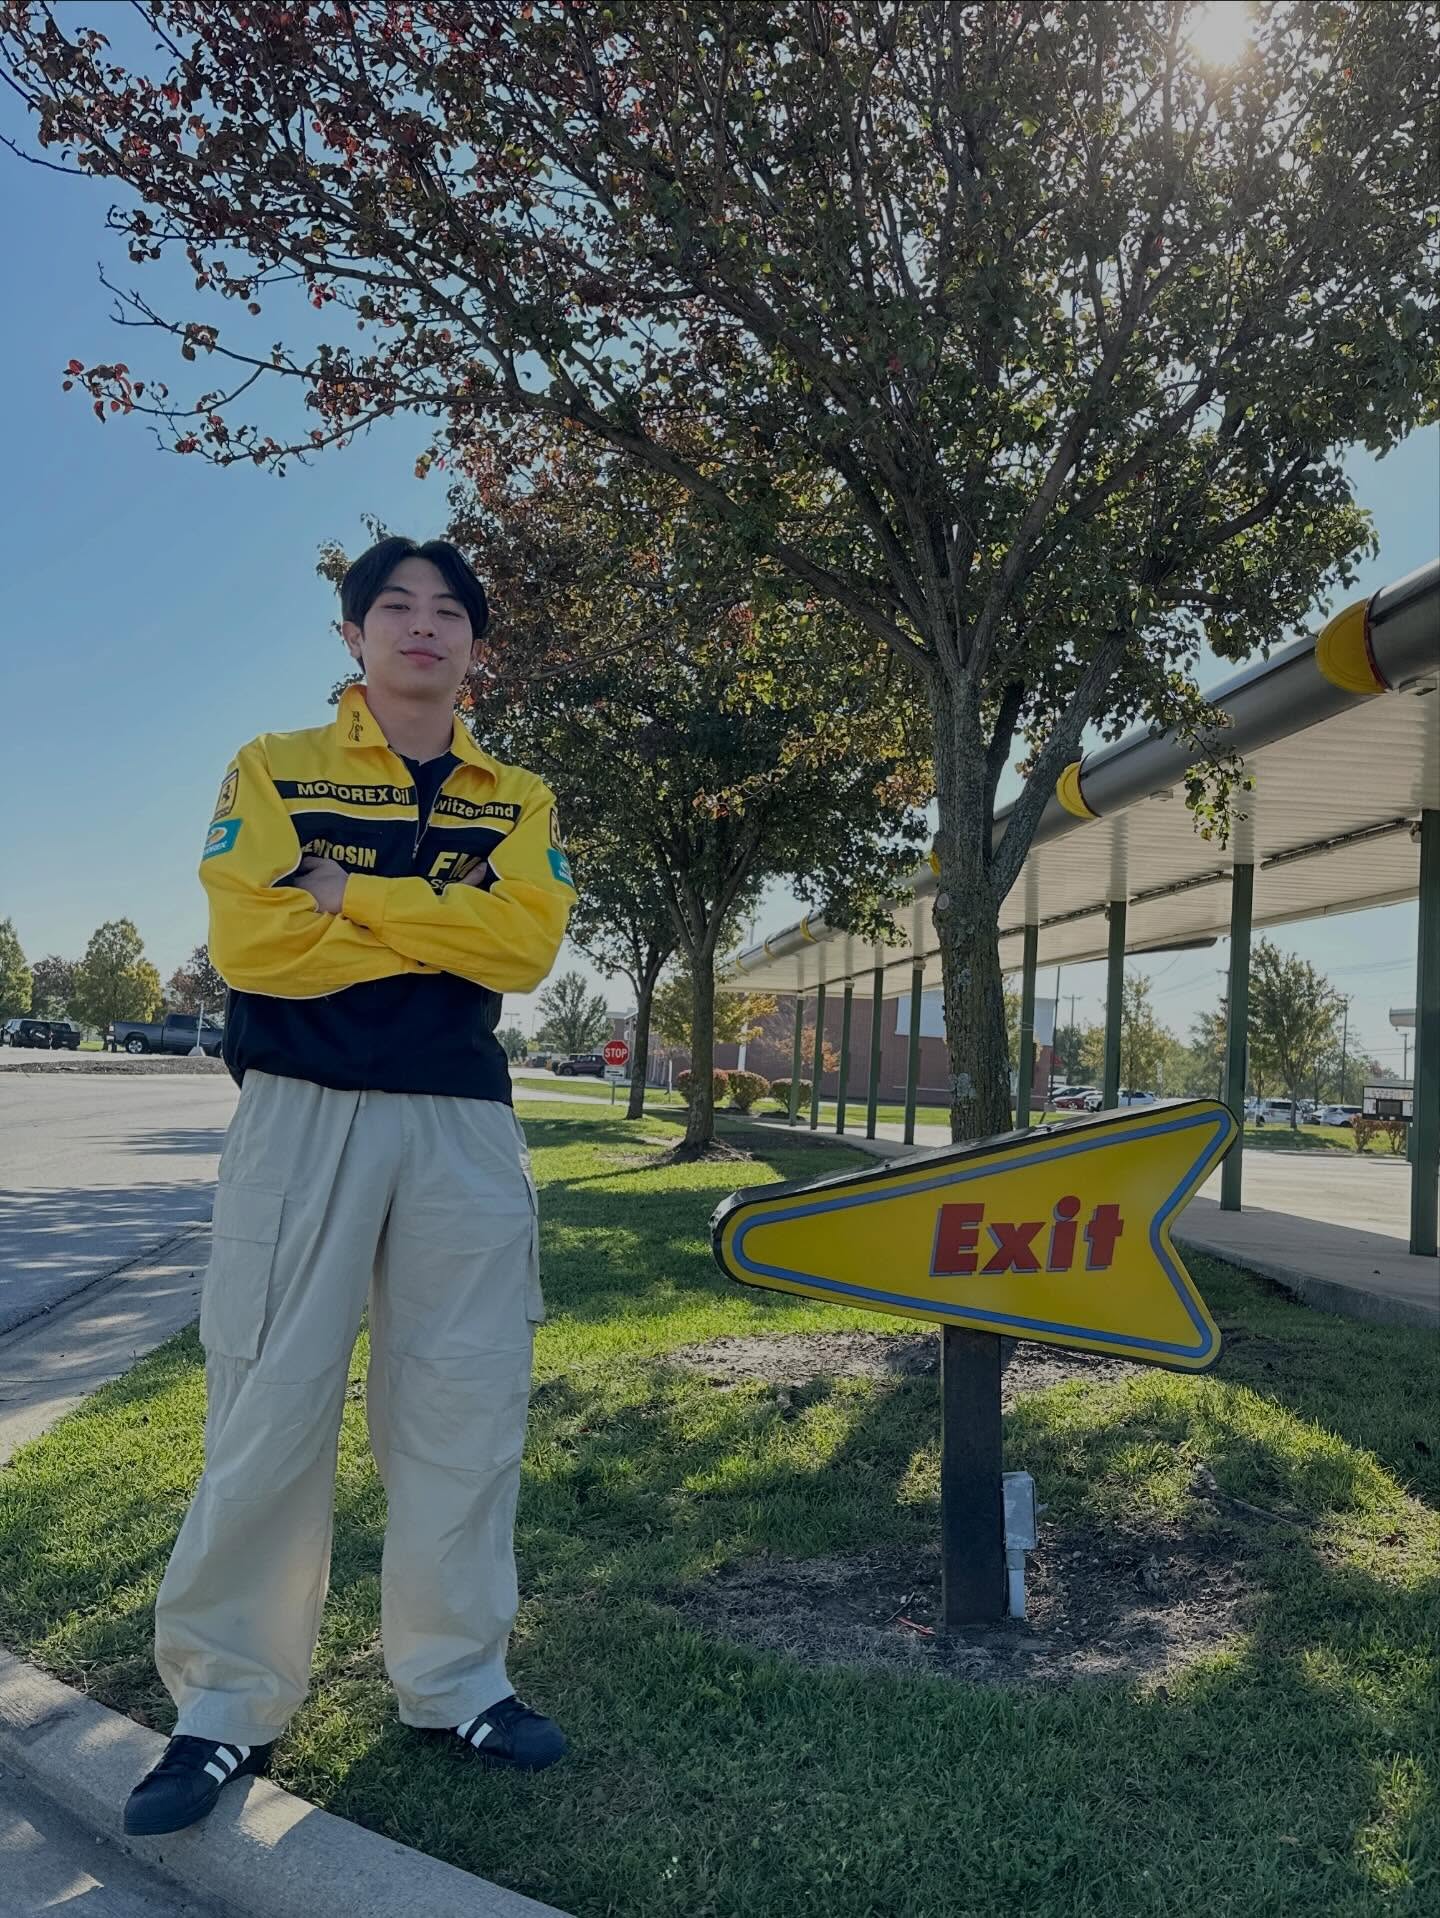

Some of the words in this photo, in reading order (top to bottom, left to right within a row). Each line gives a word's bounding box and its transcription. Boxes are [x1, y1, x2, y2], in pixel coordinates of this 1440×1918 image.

[297, 782, 389, 803] MOTOREX
[392, 787, 411, 805] Oil
[434, 798, 515, 818] witzerland
[301, 838, 377, 869] ENTOSIN
[604, 1047, 628, 1060] STOP
[929, 1195, 1125, 1277] Exit
